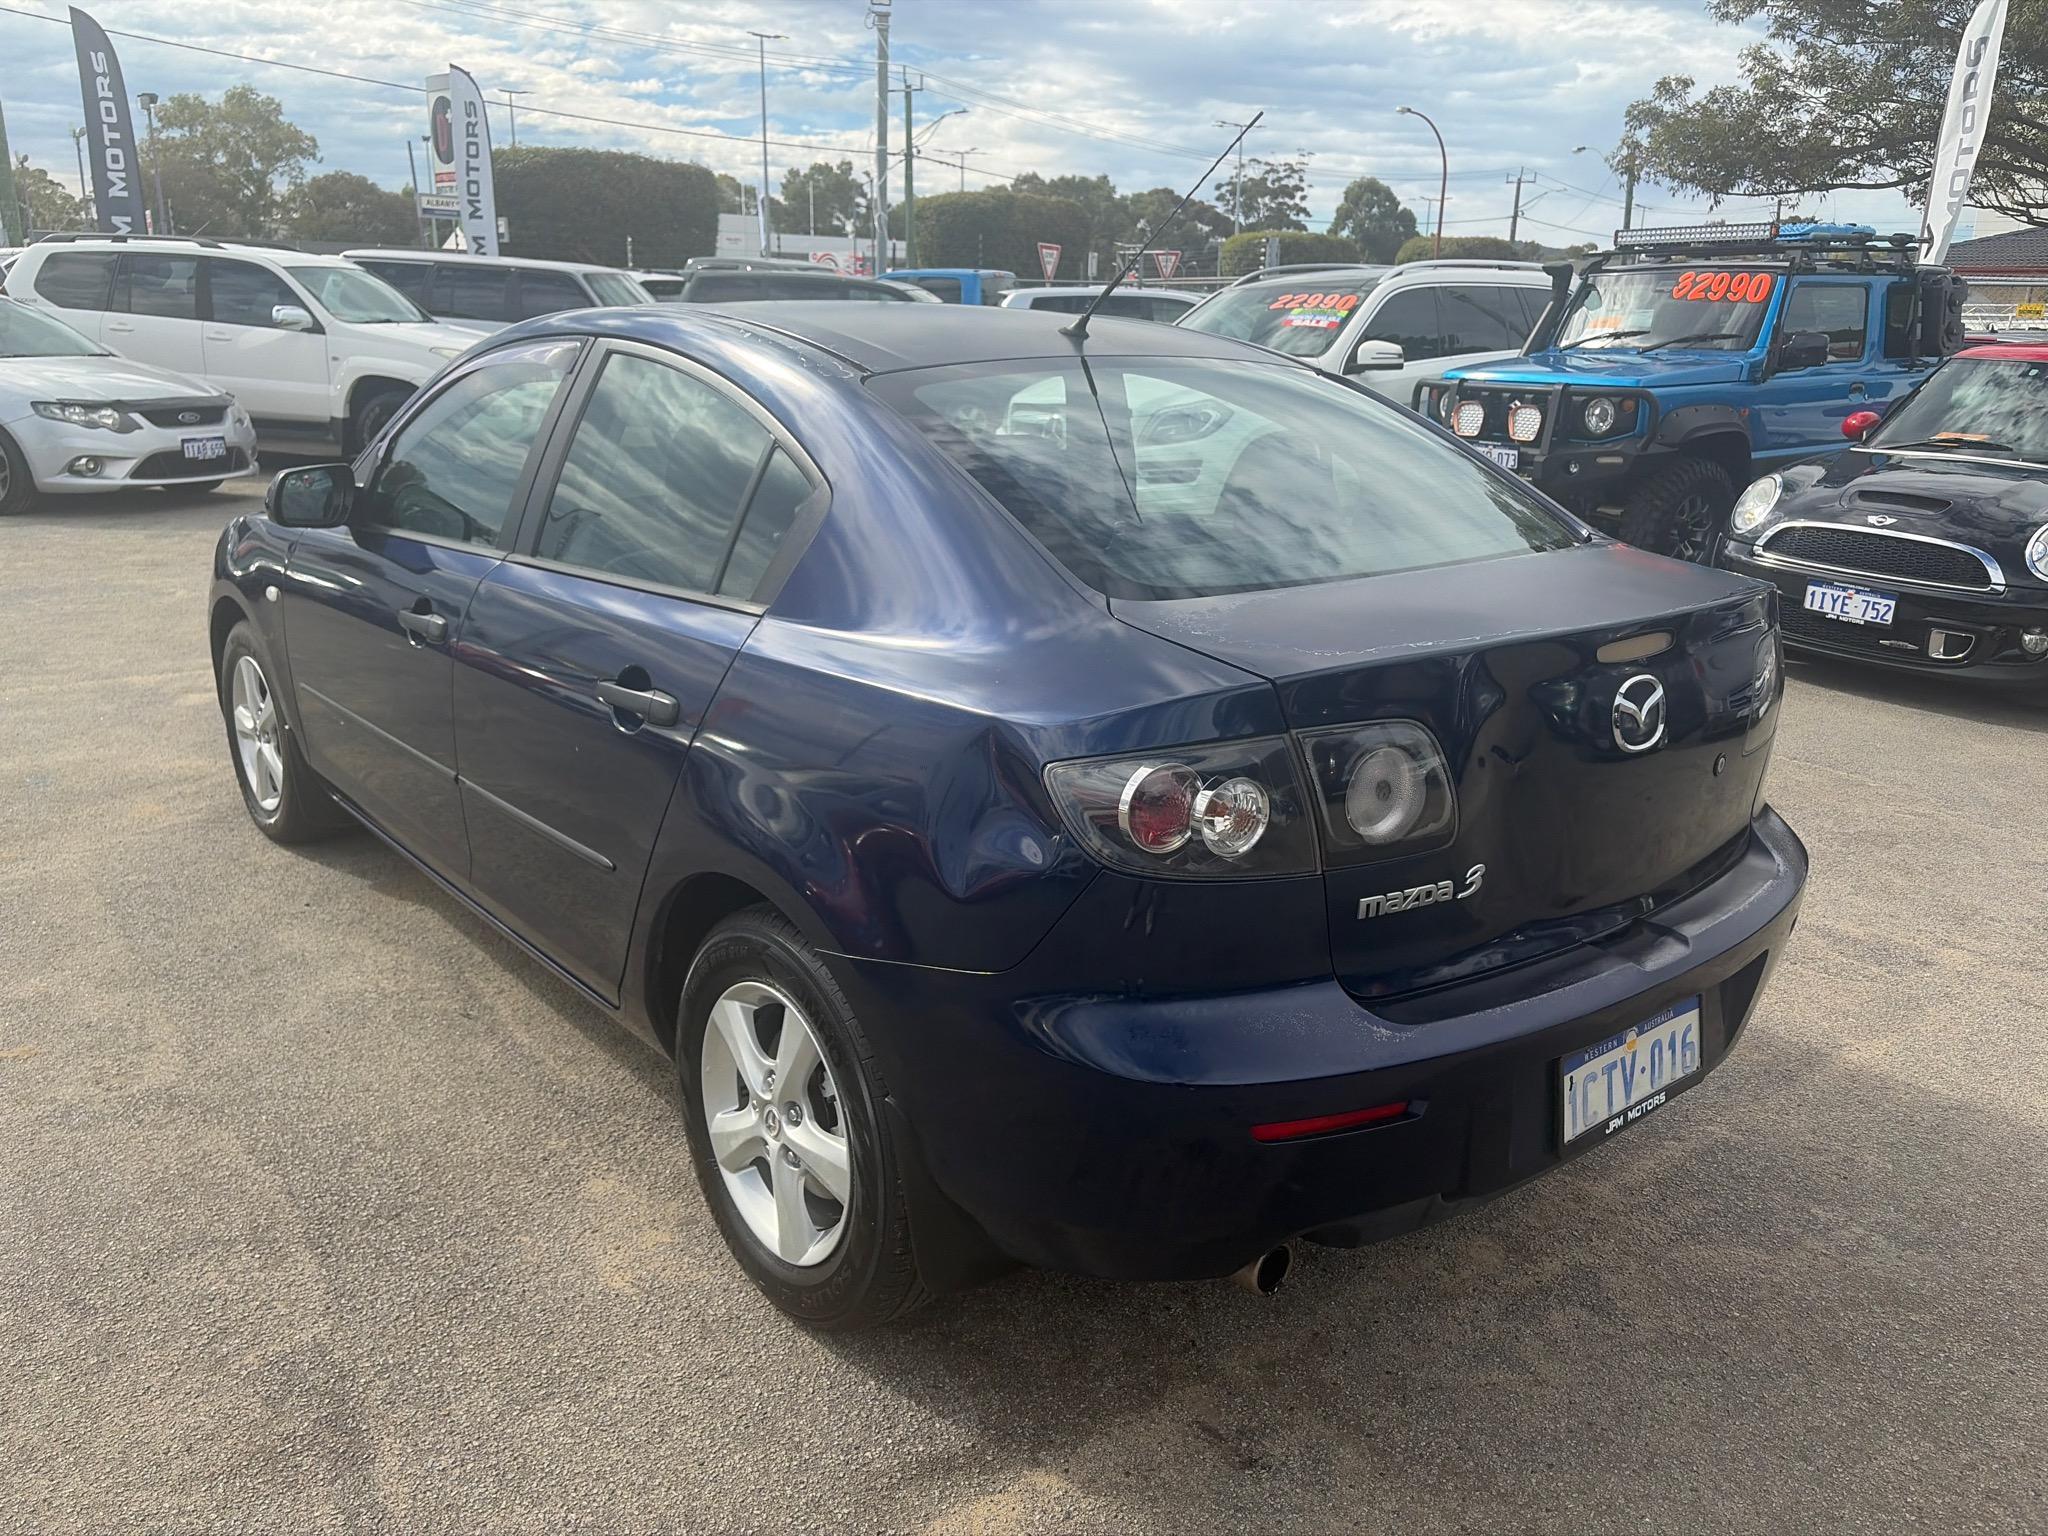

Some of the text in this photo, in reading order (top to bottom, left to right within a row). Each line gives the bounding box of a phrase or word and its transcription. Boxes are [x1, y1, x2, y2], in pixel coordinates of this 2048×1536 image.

[90, 51, 129, 198] MOTORS
[464, 100, 484, 219] MOTORS
[1268, 293, 1358, 310] 22990
[1672, 271, 1772, 303] 32990
[1291, 319, 1328, 328] SALE
[1839, 615, 1865, 625] MOTORS
[1456, 863, 1486, 899] 3
[1584, 1010, 1674, 1061] WESTERN AUSTRALIA
[1605, 1091, 1666, 1134] JPM MOTORS
